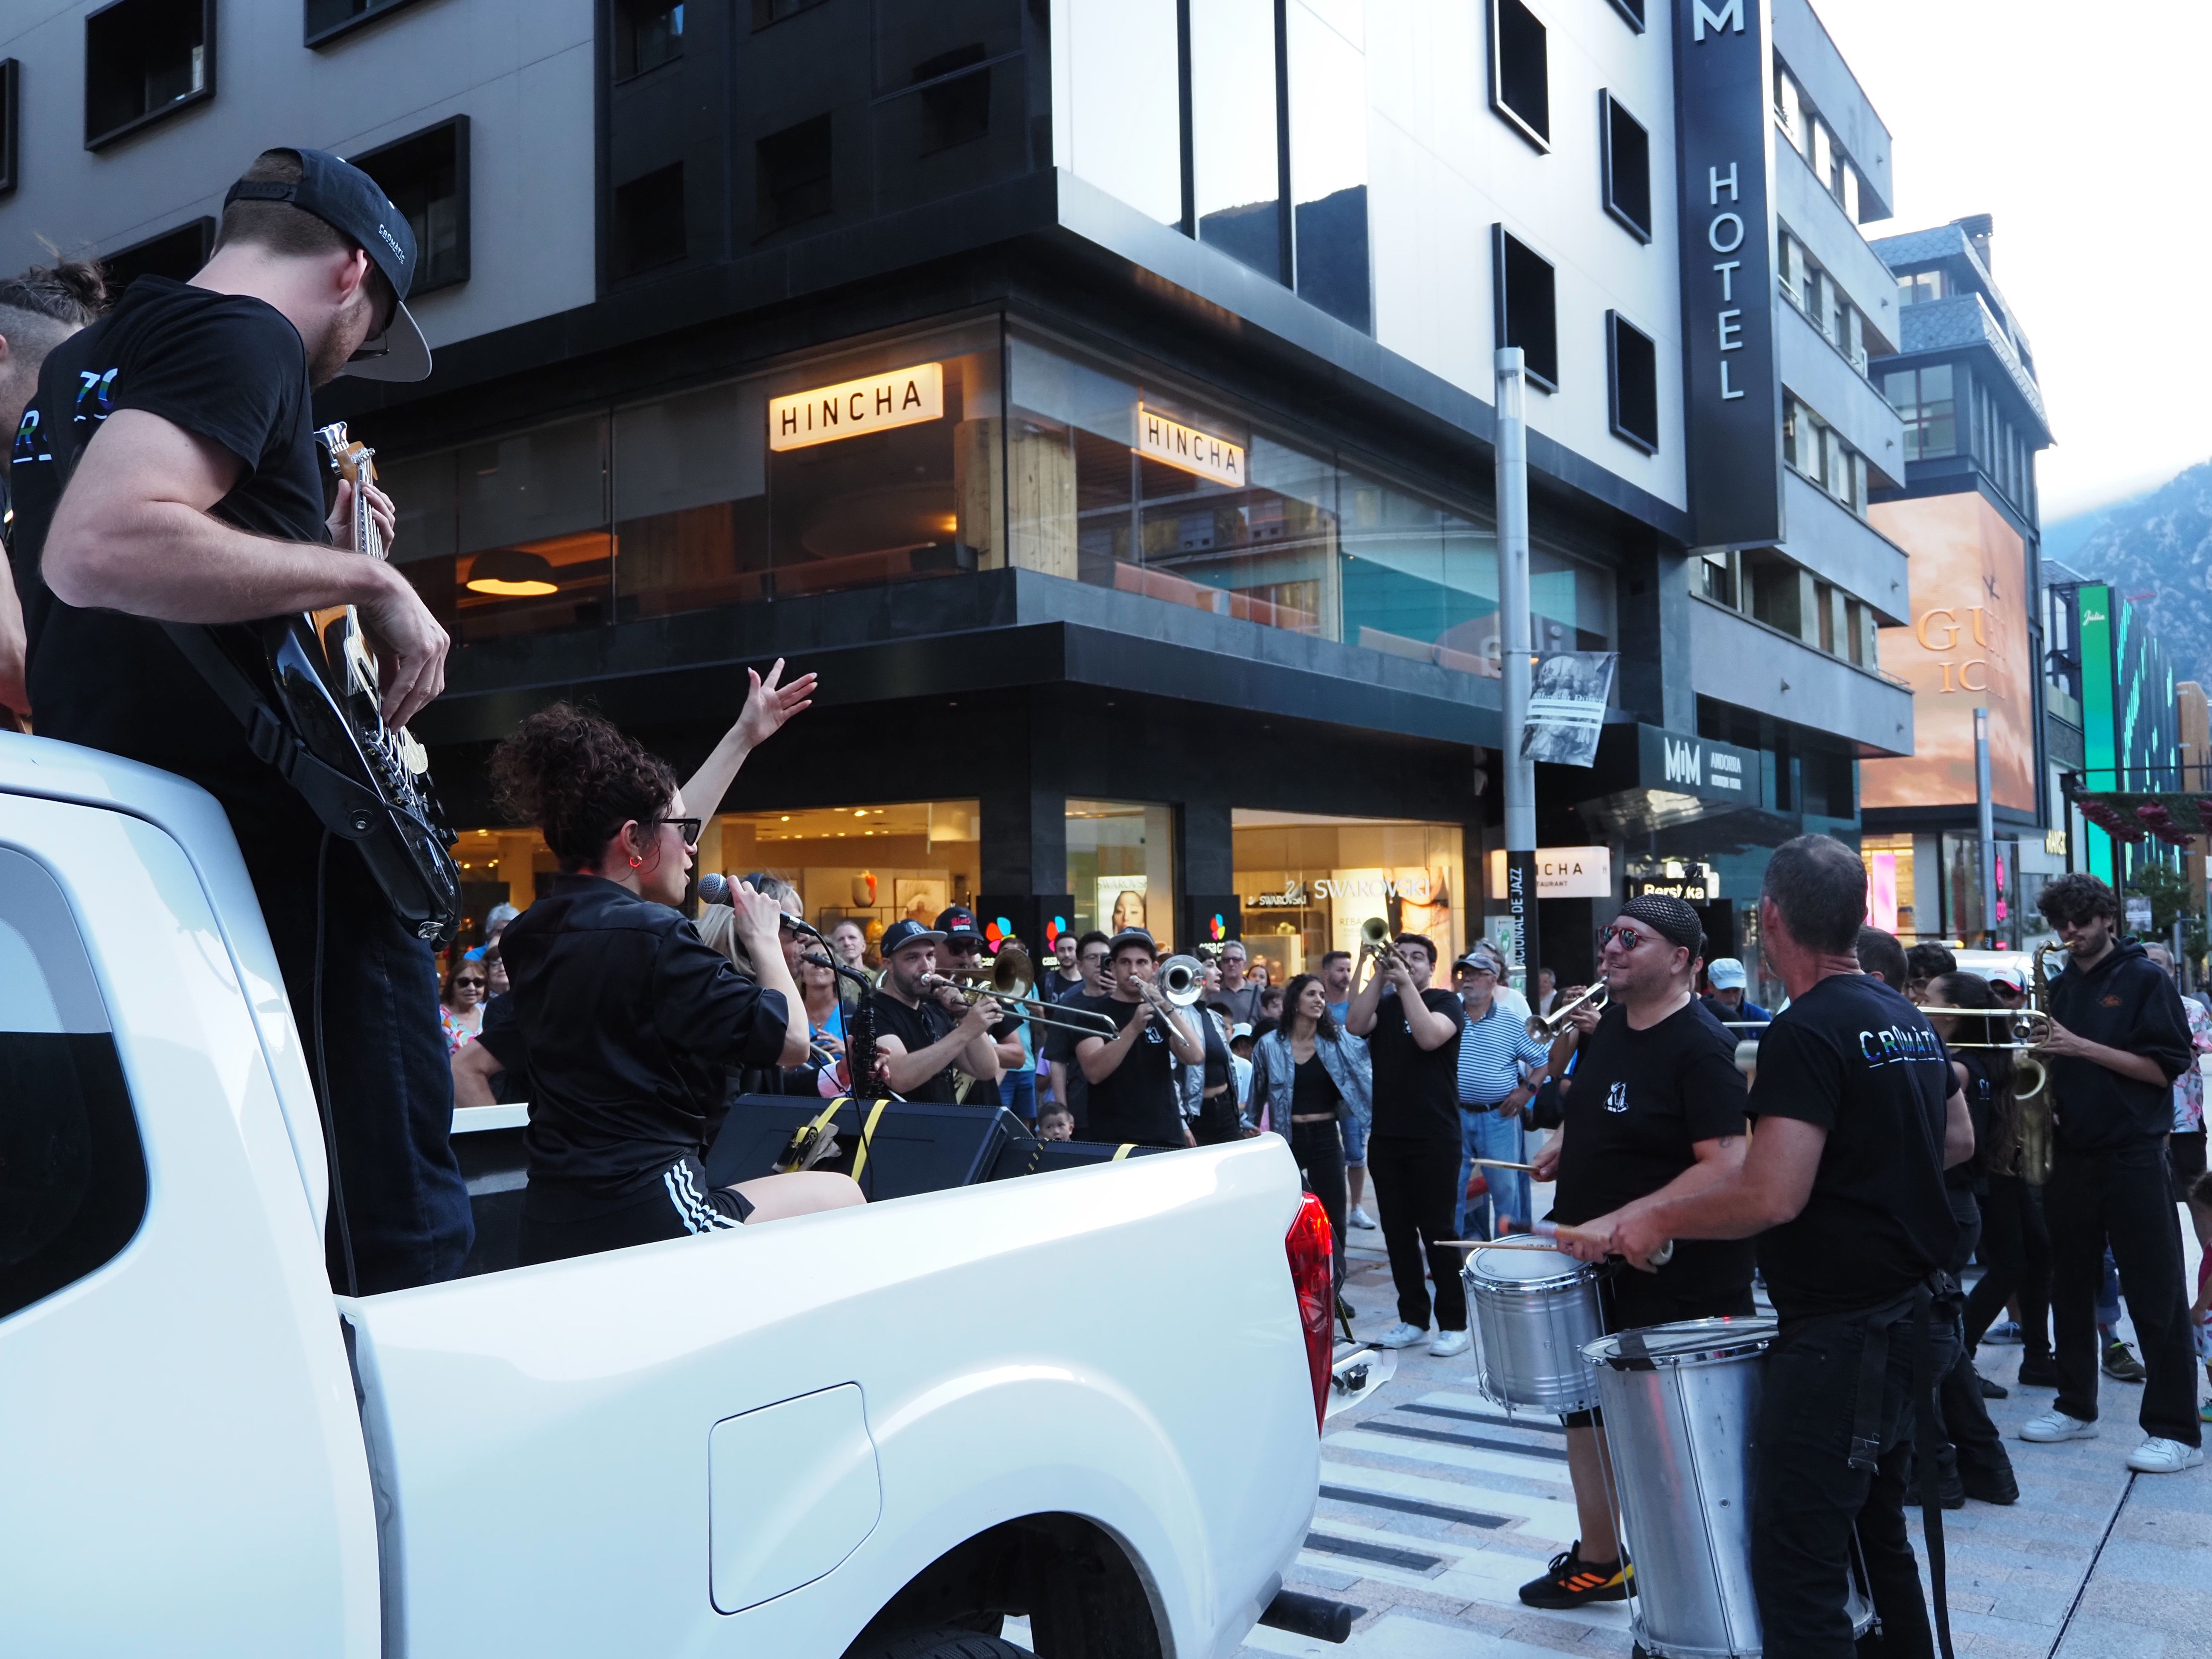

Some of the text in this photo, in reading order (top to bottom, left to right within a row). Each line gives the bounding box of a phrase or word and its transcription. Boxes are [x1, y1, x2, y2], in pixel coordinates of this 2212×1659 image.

[1708, 162, 1745, 400] HOTEL
[781, 380, 922, 436] HINCHA
[1148, 416, 1237, 474] HINCHA
[1314, 879, 1430, 899] SWAROVSKI
[1509, 867, 1523, 896] JAZZ
[1259, 894, 1307, 906] SWAROVSKI
[1511, 896, 1524, 913] DE
